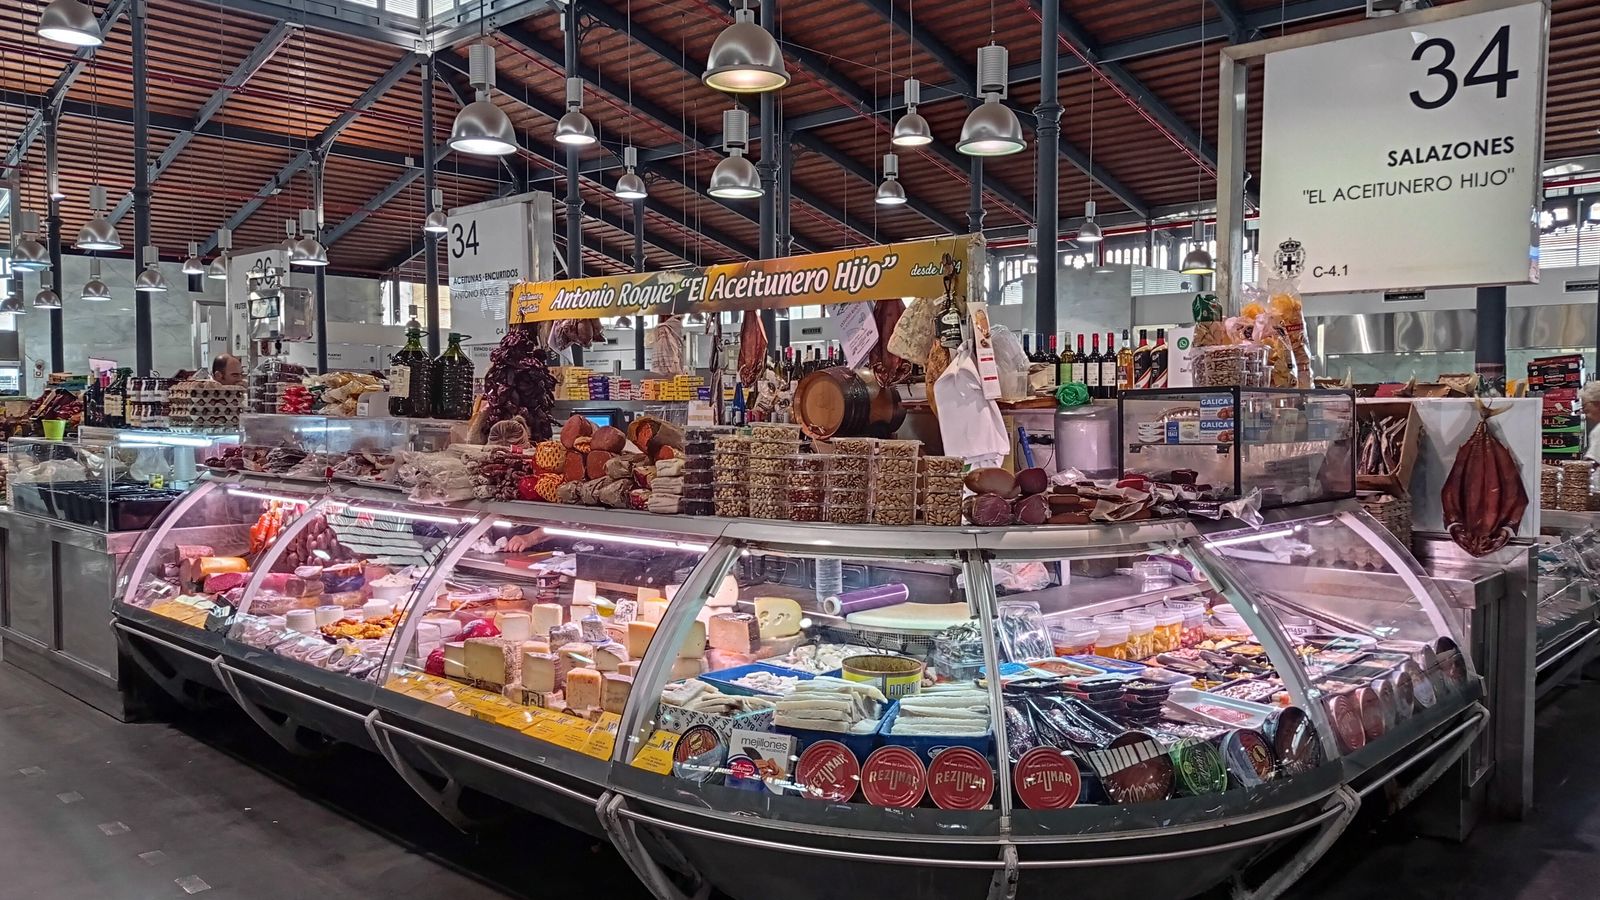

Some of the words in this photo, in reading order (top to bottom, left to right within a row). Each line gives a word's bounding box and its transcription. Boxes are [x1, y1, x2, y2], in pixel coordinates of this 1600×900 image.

[1409, 24, 1519, 110] 34
[1387, 135, 1515, 167] SALAZONES
[1302, 188, 1327, 205] "EL
[1332, 175, 1453, 202] ACEITUNERO
[1460, 167, 1516, 189] HIJO"
[451, 219, 480, 259] 34
[910, 264, 938, 276] desde
[1313, 263, 1349, 279] C-4.1
[550, 282, 614, 311] Antonio
[617, 282, 675, 311] Roque
[709, 266, 829, 301] Aceitunero
[832, 253, 899, 294] Hijo”
[454, 289, 479, 300] ANTONIO
[480, 286, 500, 298] ROQUE
[1201, 398, 1229, 406] GALICA
[1201, 421, 1229, 429] GALICA
[740, 737, 788, 751] mejillones
[869, 770, 921, 791] REZUMAR
[935, 770, 986, 792] REZUMAR
[1023, 770, 1073, 791] REZUMAR
